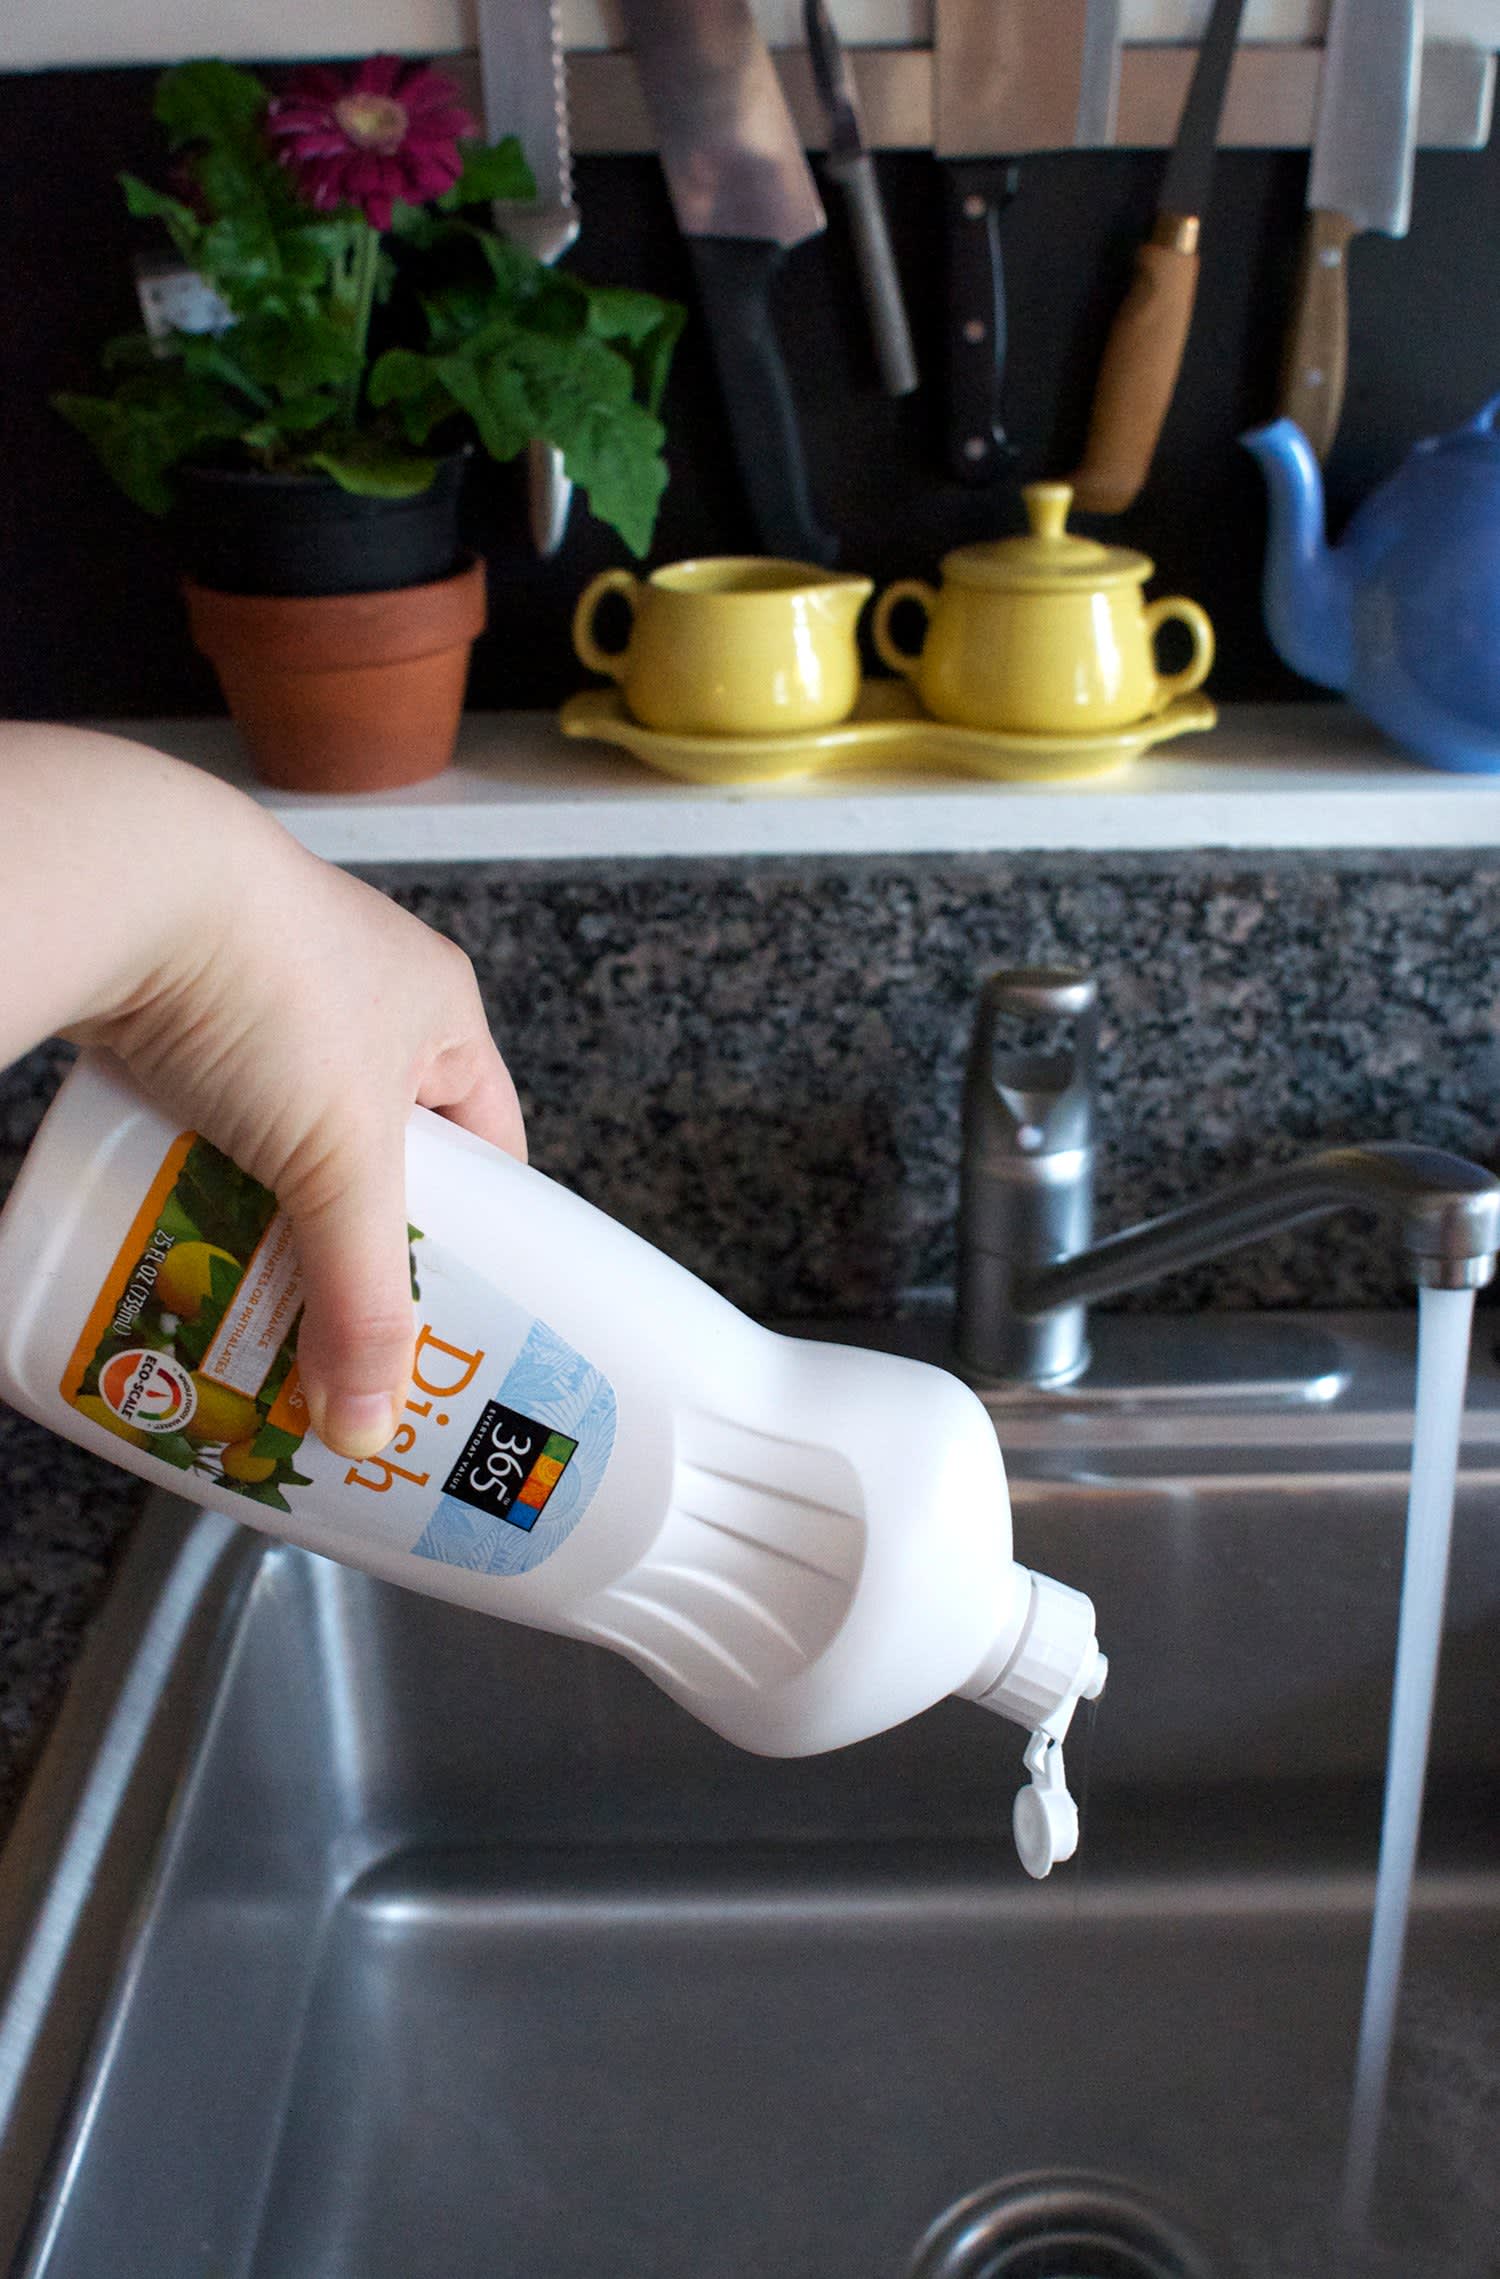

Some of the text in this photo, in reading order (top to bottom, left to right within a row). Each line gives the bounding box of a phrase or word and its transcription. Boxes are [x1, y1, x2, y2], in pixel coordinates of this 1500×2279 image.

[112, 1229, 175, 1336] 25 FL OZ (739mL)
[214, 1216, 294, 1375] HOSPHATES OR PHTHALATES
[257, 1280, 297, 1350] FRAGRANCE
[121, 1355, 158, 1421] ECO-SCALE
[449, 1408, 497, 1490] EVERYDAY VALUE
